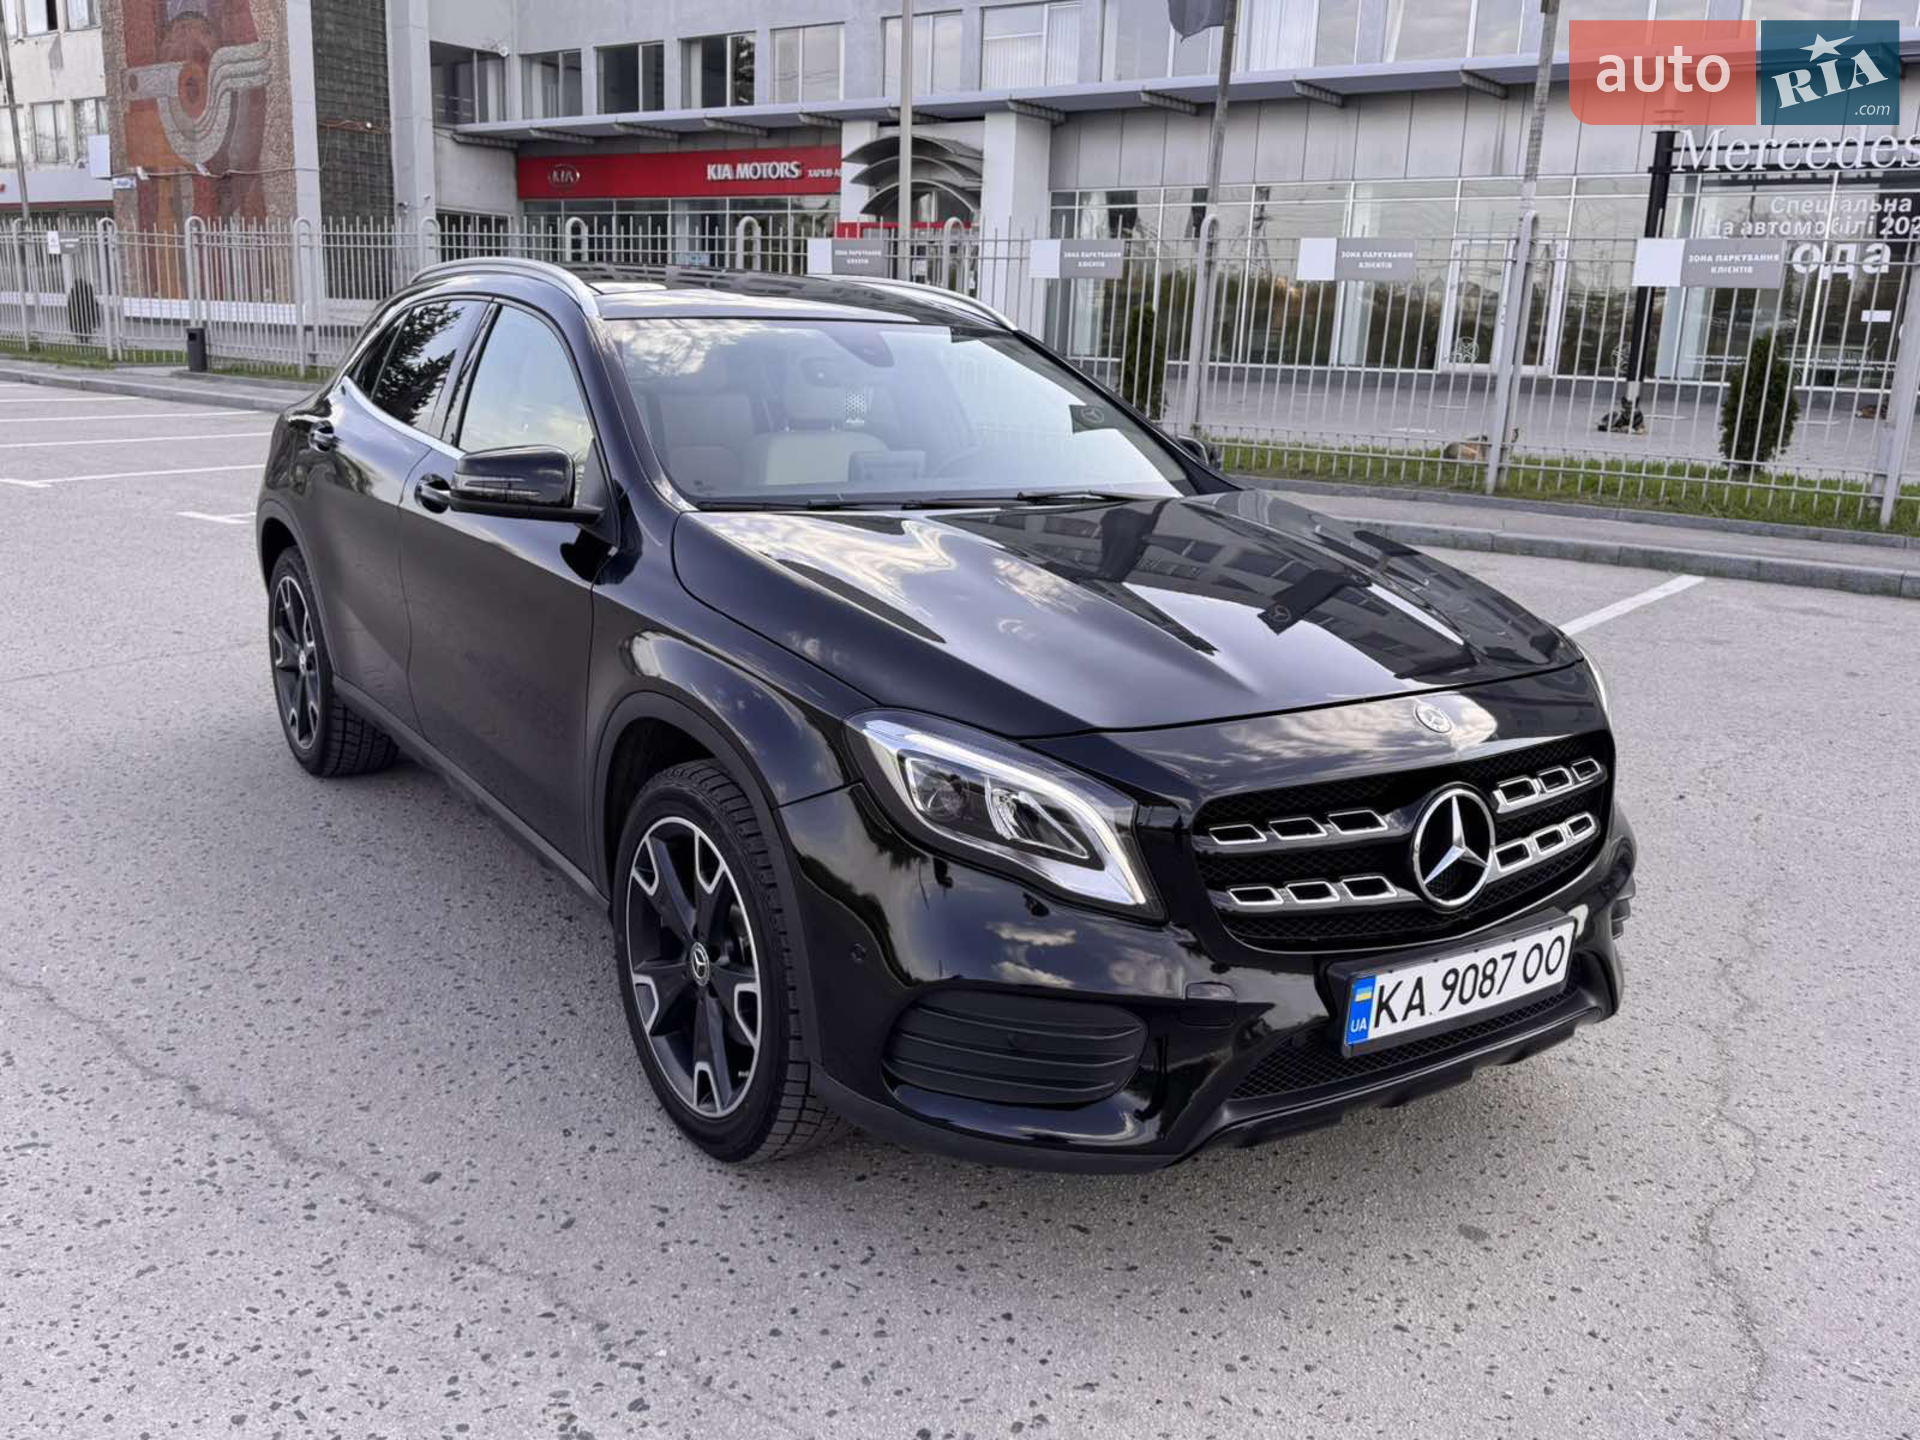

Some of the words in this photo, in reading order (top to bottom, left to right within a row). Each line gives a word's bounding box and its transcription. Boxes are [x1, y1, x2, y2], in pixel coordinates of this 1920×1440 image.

[1672, 125, 1920, 172] Mercedes
[707, 163, 733, 180] KIA
[736, 161, 801, 180] MOTORS
[1771, 196, 1912, 215] Спеціальна
[1689, 254, 1713, 262] ЗОНА
[1373, 975, 1426, 1028] KA
[1439, 950, 1518, 1012] 9087
[1350, 1018, 1368, 1033] UA
